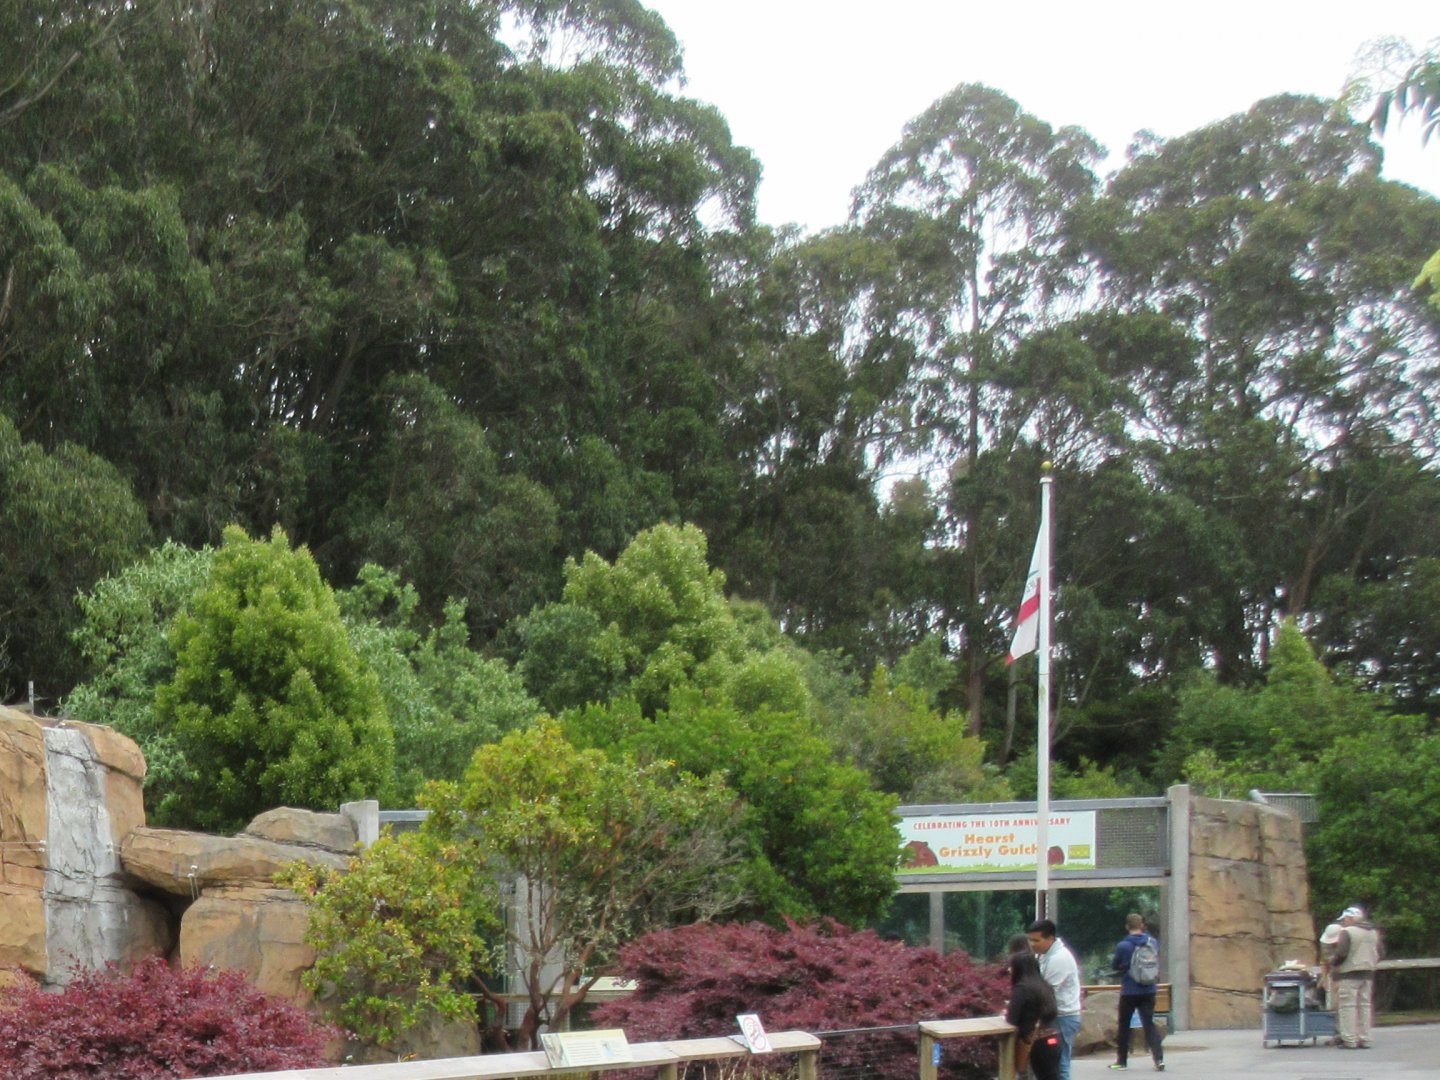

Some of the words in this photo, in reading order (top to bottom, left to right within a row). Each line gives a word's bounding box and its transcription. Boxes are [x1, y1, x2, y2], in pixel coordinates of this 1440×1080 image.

[913, 821, 968, 830] CELEBRATING
[971, 820, 985, 828] THE
[990, 819, 1009, 827] 10TH
[1013, 817, 1071, 826] ANNIVSARY
[964, 833, 1015, 844] Hearst
[939, 845, 993, 858] Grizzly
